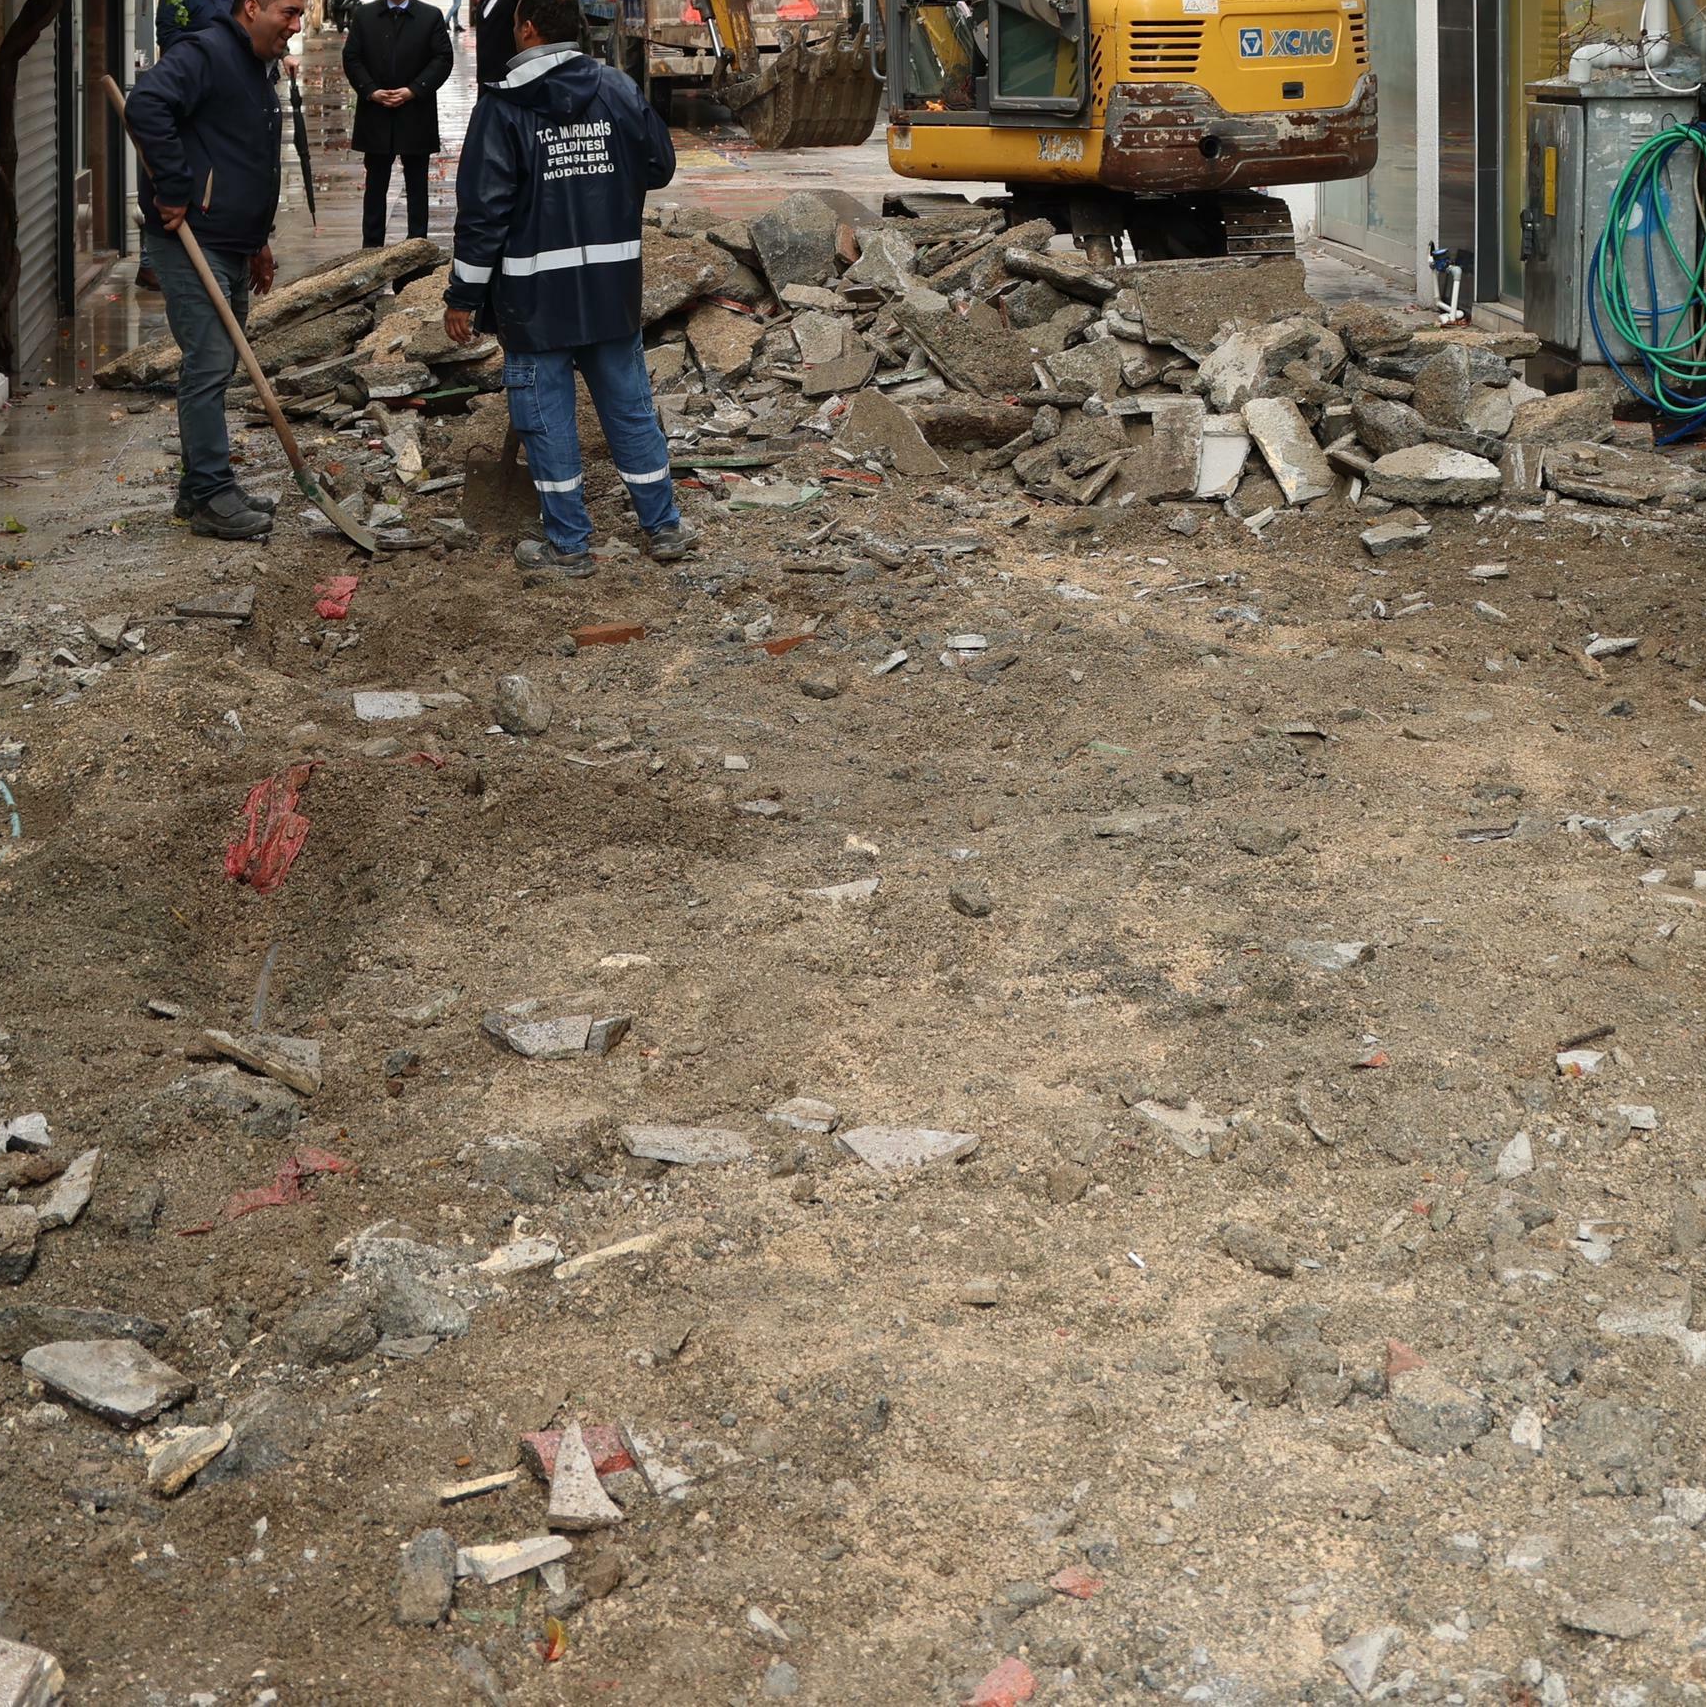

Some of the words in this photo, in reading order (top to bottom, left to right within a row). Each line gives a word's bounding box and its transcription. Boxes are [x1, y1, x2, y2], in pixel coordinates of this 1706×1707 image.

[1267, 28, 1334, 57] XCMG
[547, 136, 606, 156] BELDİYESİ
[547, 154, 573, 167] FEN
[572, 150, 609, 165] ŞLERİ
[543, 162, 615, 181] MÜDRLÜĞÜ
